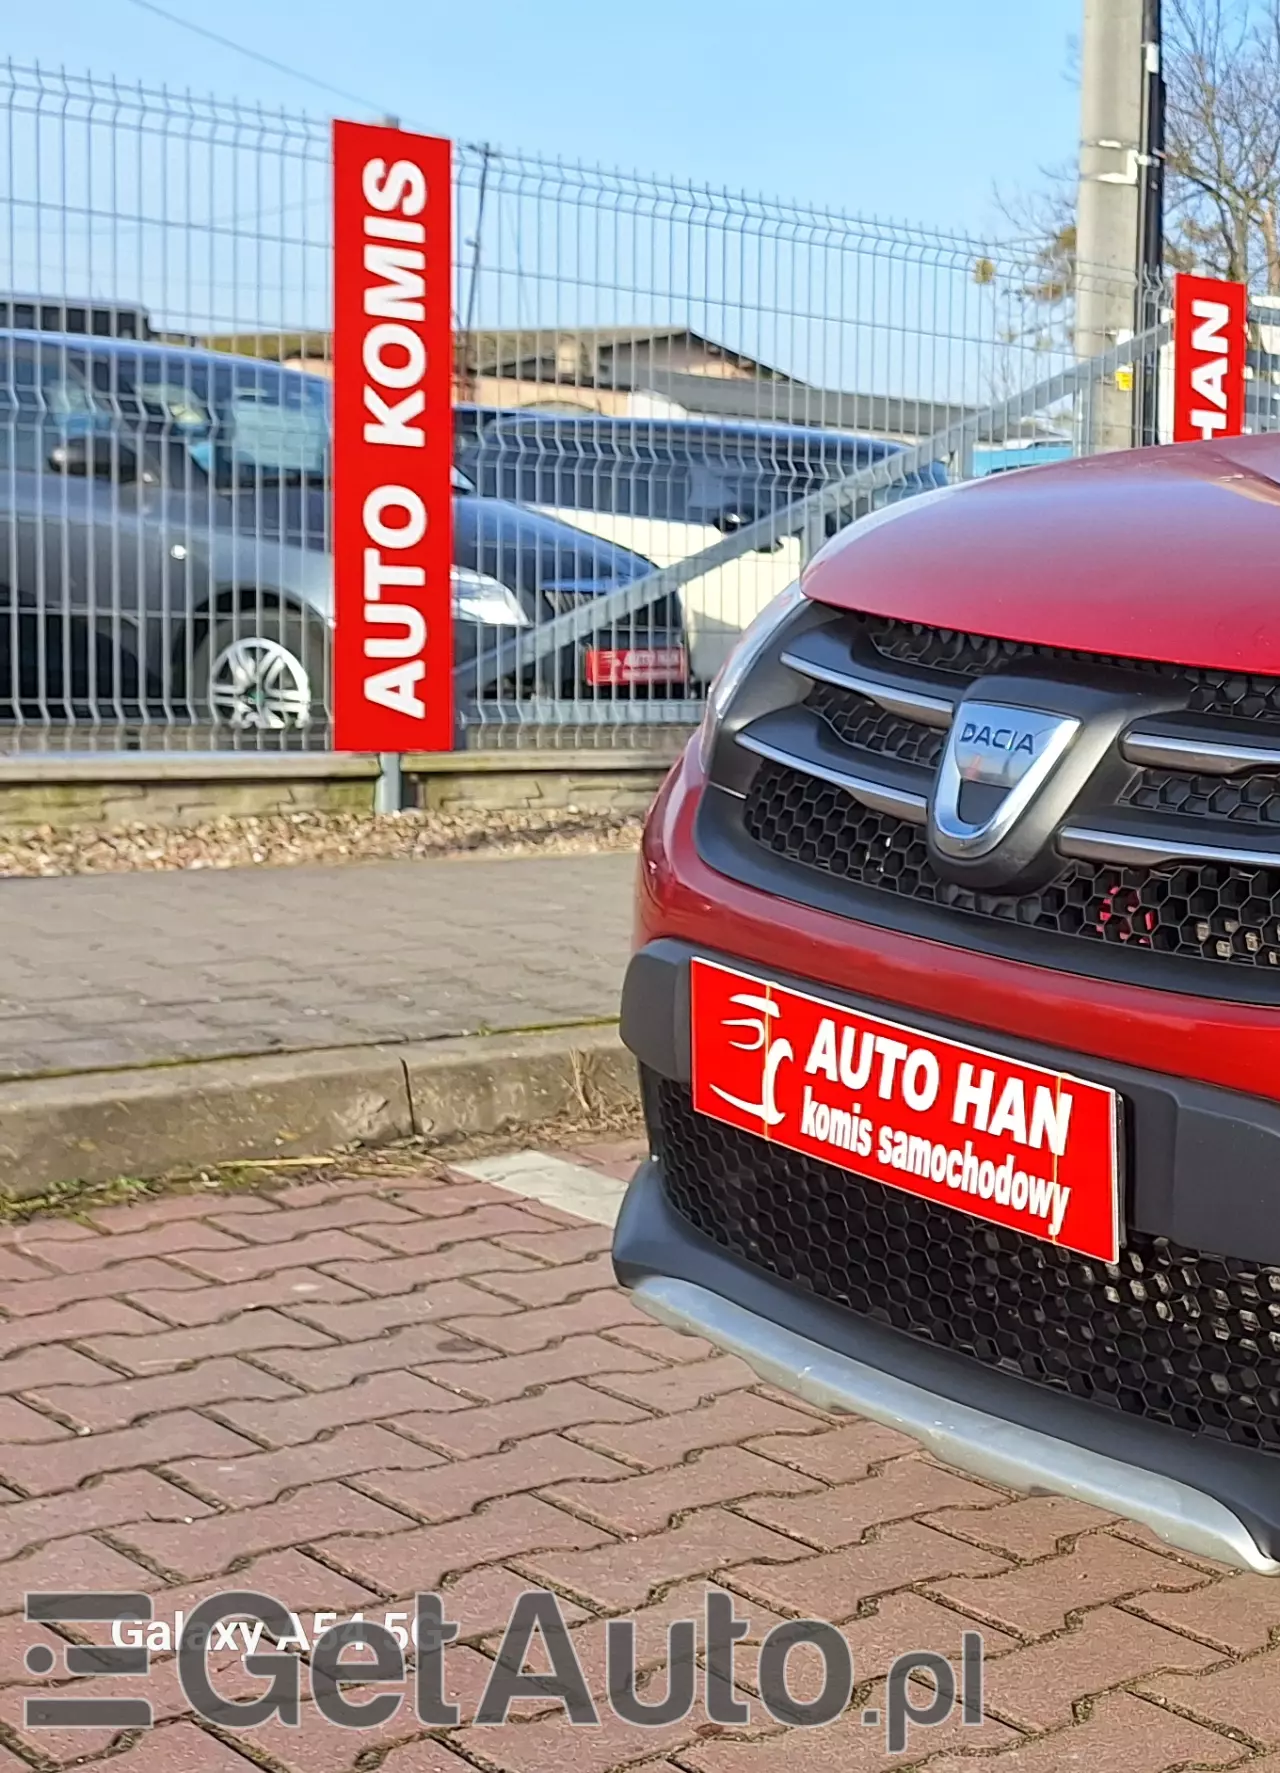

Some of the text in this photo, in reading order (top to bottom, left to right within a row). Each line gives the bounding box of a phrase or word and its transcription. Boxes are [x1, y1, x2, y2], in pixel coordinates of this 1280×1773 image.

[362, 157, 427, 720] AUTO KOMIS
[959, 723, 1034, 755] DACIA
[804, 1018, 1073, 1157] AUTO HAN
[800, 1085, 1071, 1236] komis samochodowy
